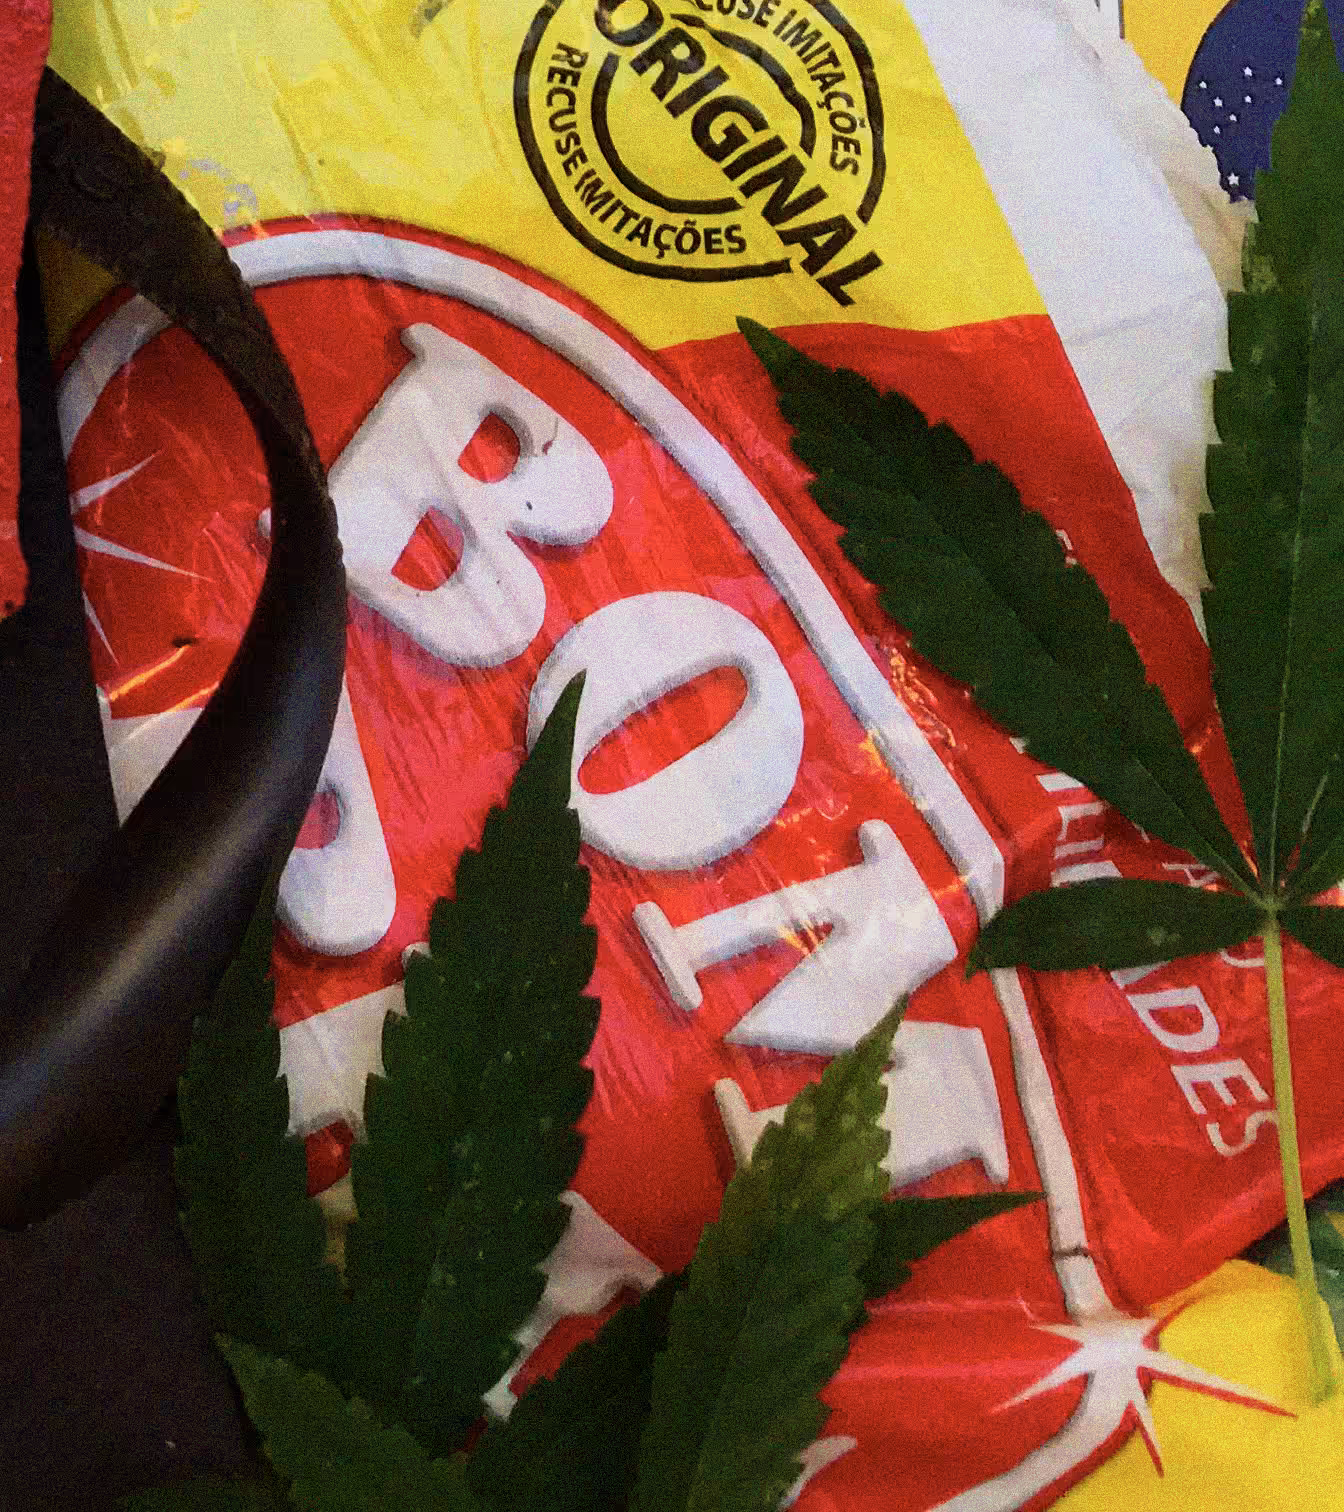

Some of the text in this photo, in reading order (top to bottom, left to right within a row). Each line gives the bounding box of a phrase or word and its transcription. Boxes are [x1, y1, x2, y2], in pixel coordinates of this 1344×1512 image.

[547, 42, 748, 256] RECUSE IMITAÇÕES
[773, 8, 868, 178] IMITAÇÕES
